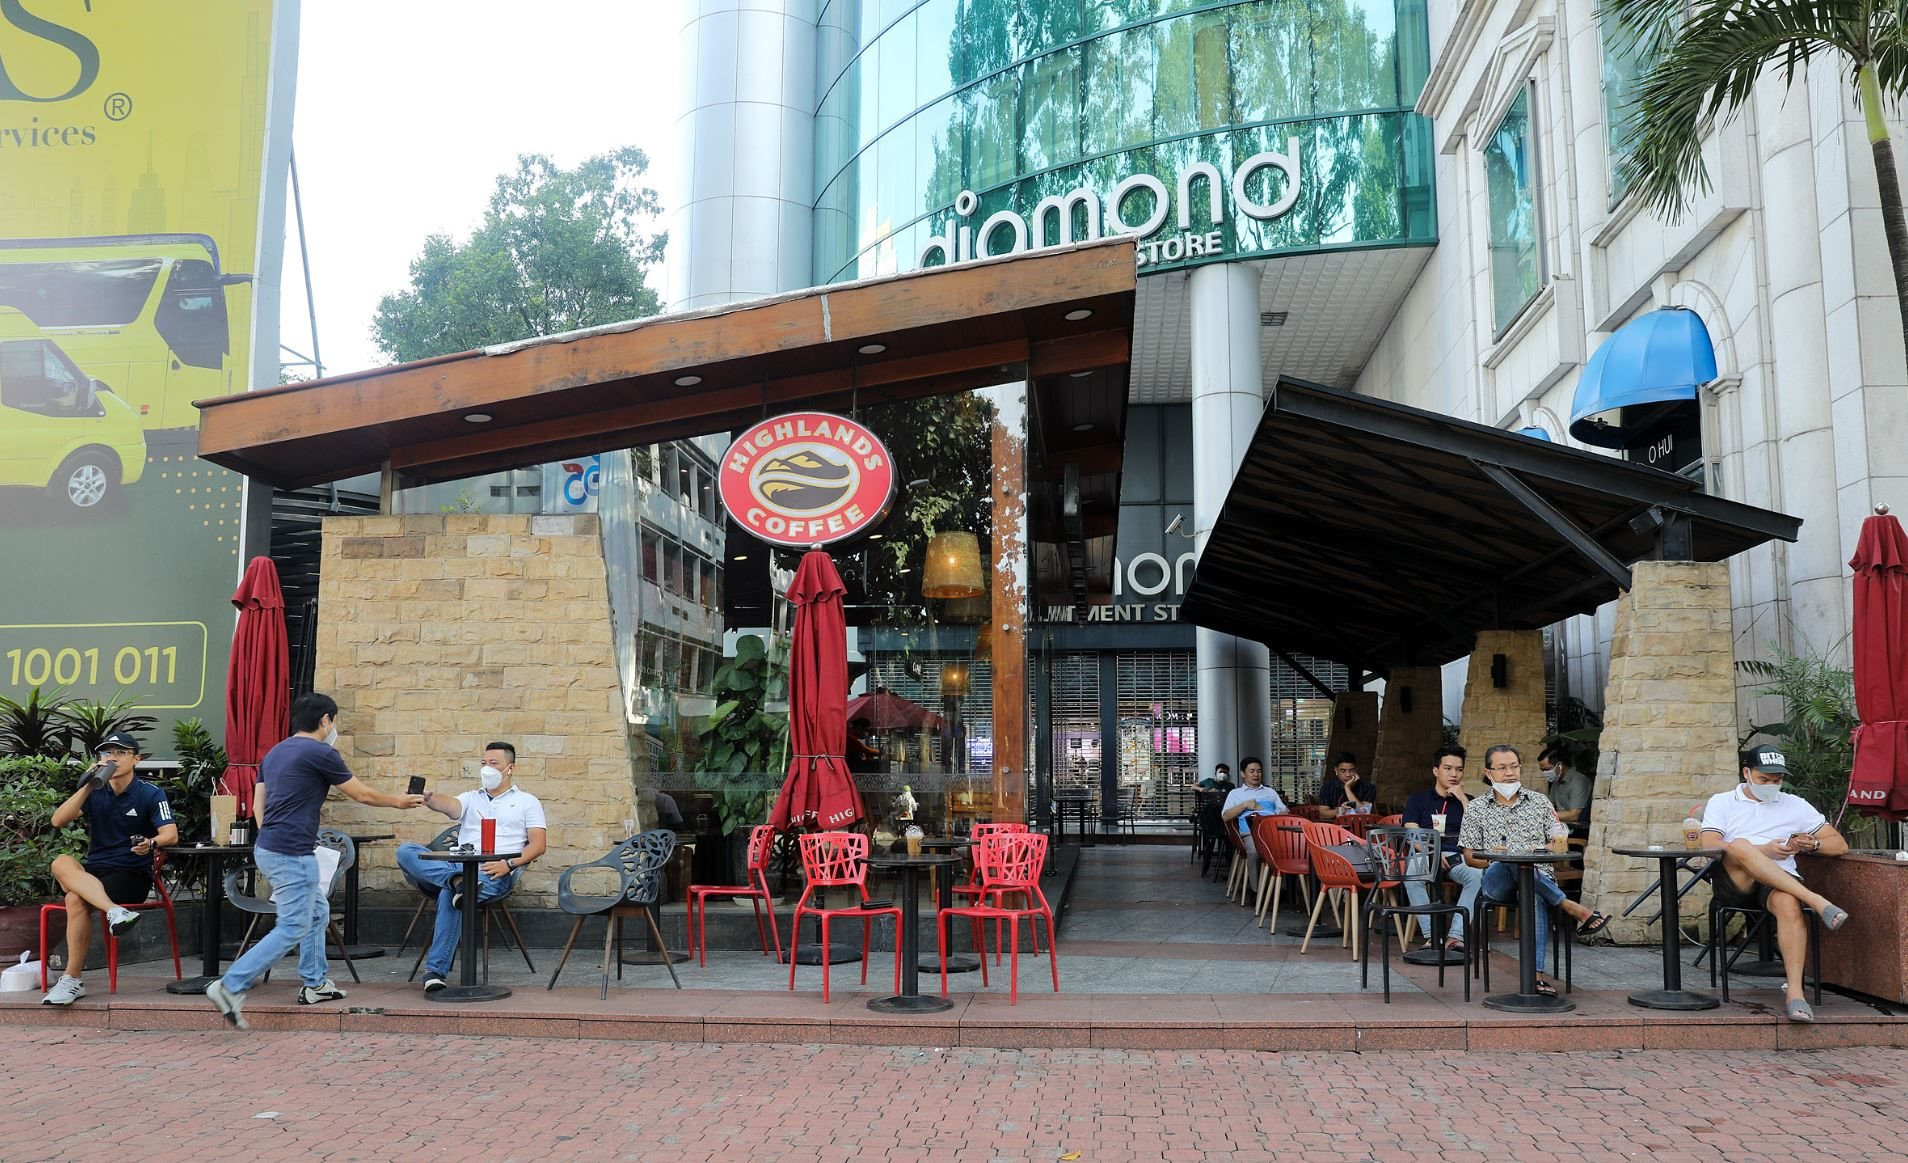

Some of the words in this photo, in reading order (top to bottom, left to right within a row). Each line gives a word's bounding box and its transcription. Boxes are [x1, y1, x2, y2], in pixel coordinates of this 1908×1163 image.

[918, 136, 1301, 267] diamond
[729, 420, 883, 474] HIGHLANDS
[1658, 434, 1672, 459] HUI
[746, 505, 865, 537] COFFEE
[6, 647, 99, 686] 1001
[114, 646, 177, 685] 011
[1849, 789, 1887, 800] AND
